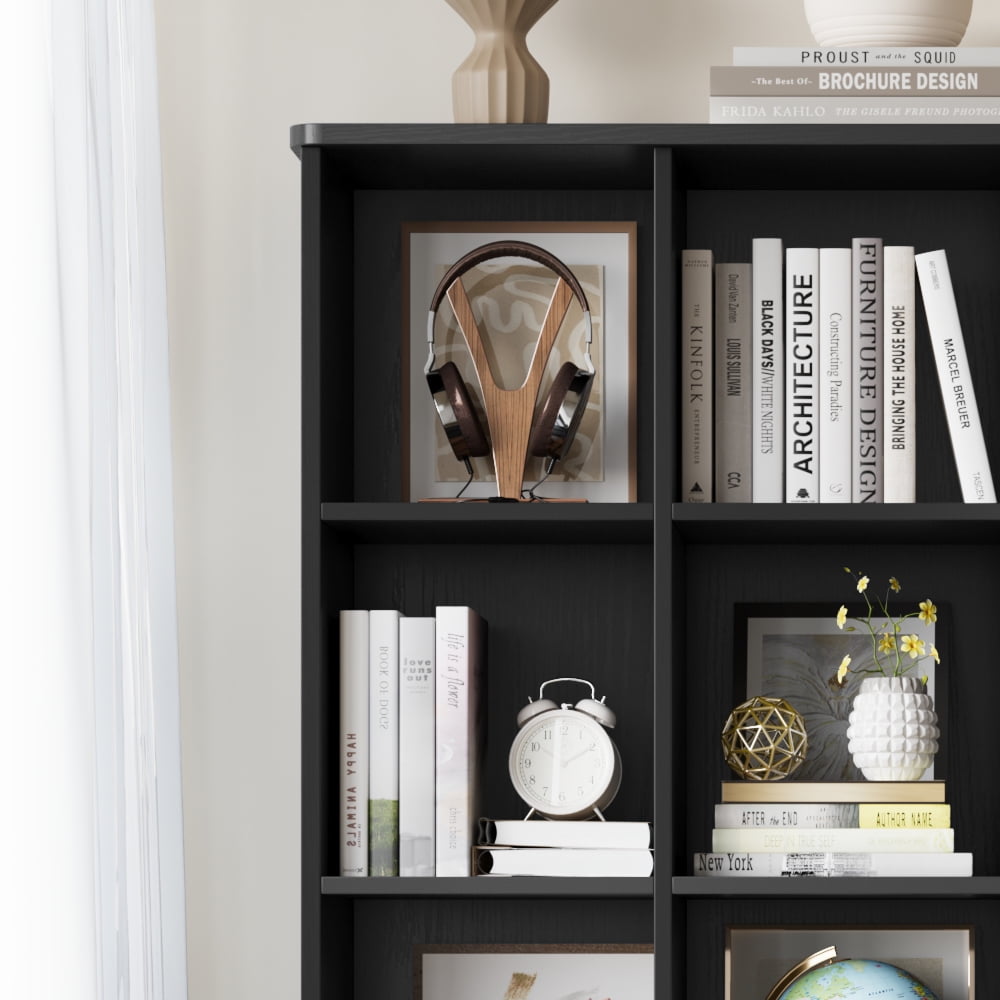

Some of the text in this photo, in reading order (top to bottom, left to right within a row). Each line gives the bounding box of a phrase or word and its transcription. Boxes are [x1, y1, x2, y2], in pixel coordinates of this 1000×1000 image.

[801, 51, 870, 64] PROUST
[914, 50, 957, 64] SQUID
[775, 72, 978, 90] Best BROCHURE DESIGN
[721, 106, 767, 118] FRIDA
[773, 106, 825, 118] KAHLO
[836, 107, 858, 116] THE
[904, 107, 950, 116] FREUND
[760, 300, 774, 336] BLACK
[726, 338, 741, 360] LOUIS
[689, 325, 703, 403] KINFOLK
[793, 274, 813, 474] ARCHITECTURE
[827, 312, 843, 422] Constructing Paradies
[859, 243, 877, 503] FURNITURE DESIGN
[891, 305, 906, 450] BRINGING THE HOUSE HOME
[726, 361, 741, 396] SULLIVAN
[943, 338, 970, 429] MARCEL BREUER
[441, 633, 465, 709] life is flower
[531, 742, 541, 752] 10
[524, 759, 532, 769] 9
[529, 775, 536, 785] 8
[741, 811, 766, 826] AFTER
[782, 811, 798, 826] END
[876, 812, 907, 827] AUTHOR
[911, 812, 934, 827] NAME
[698, 853, 753, 872] New York
